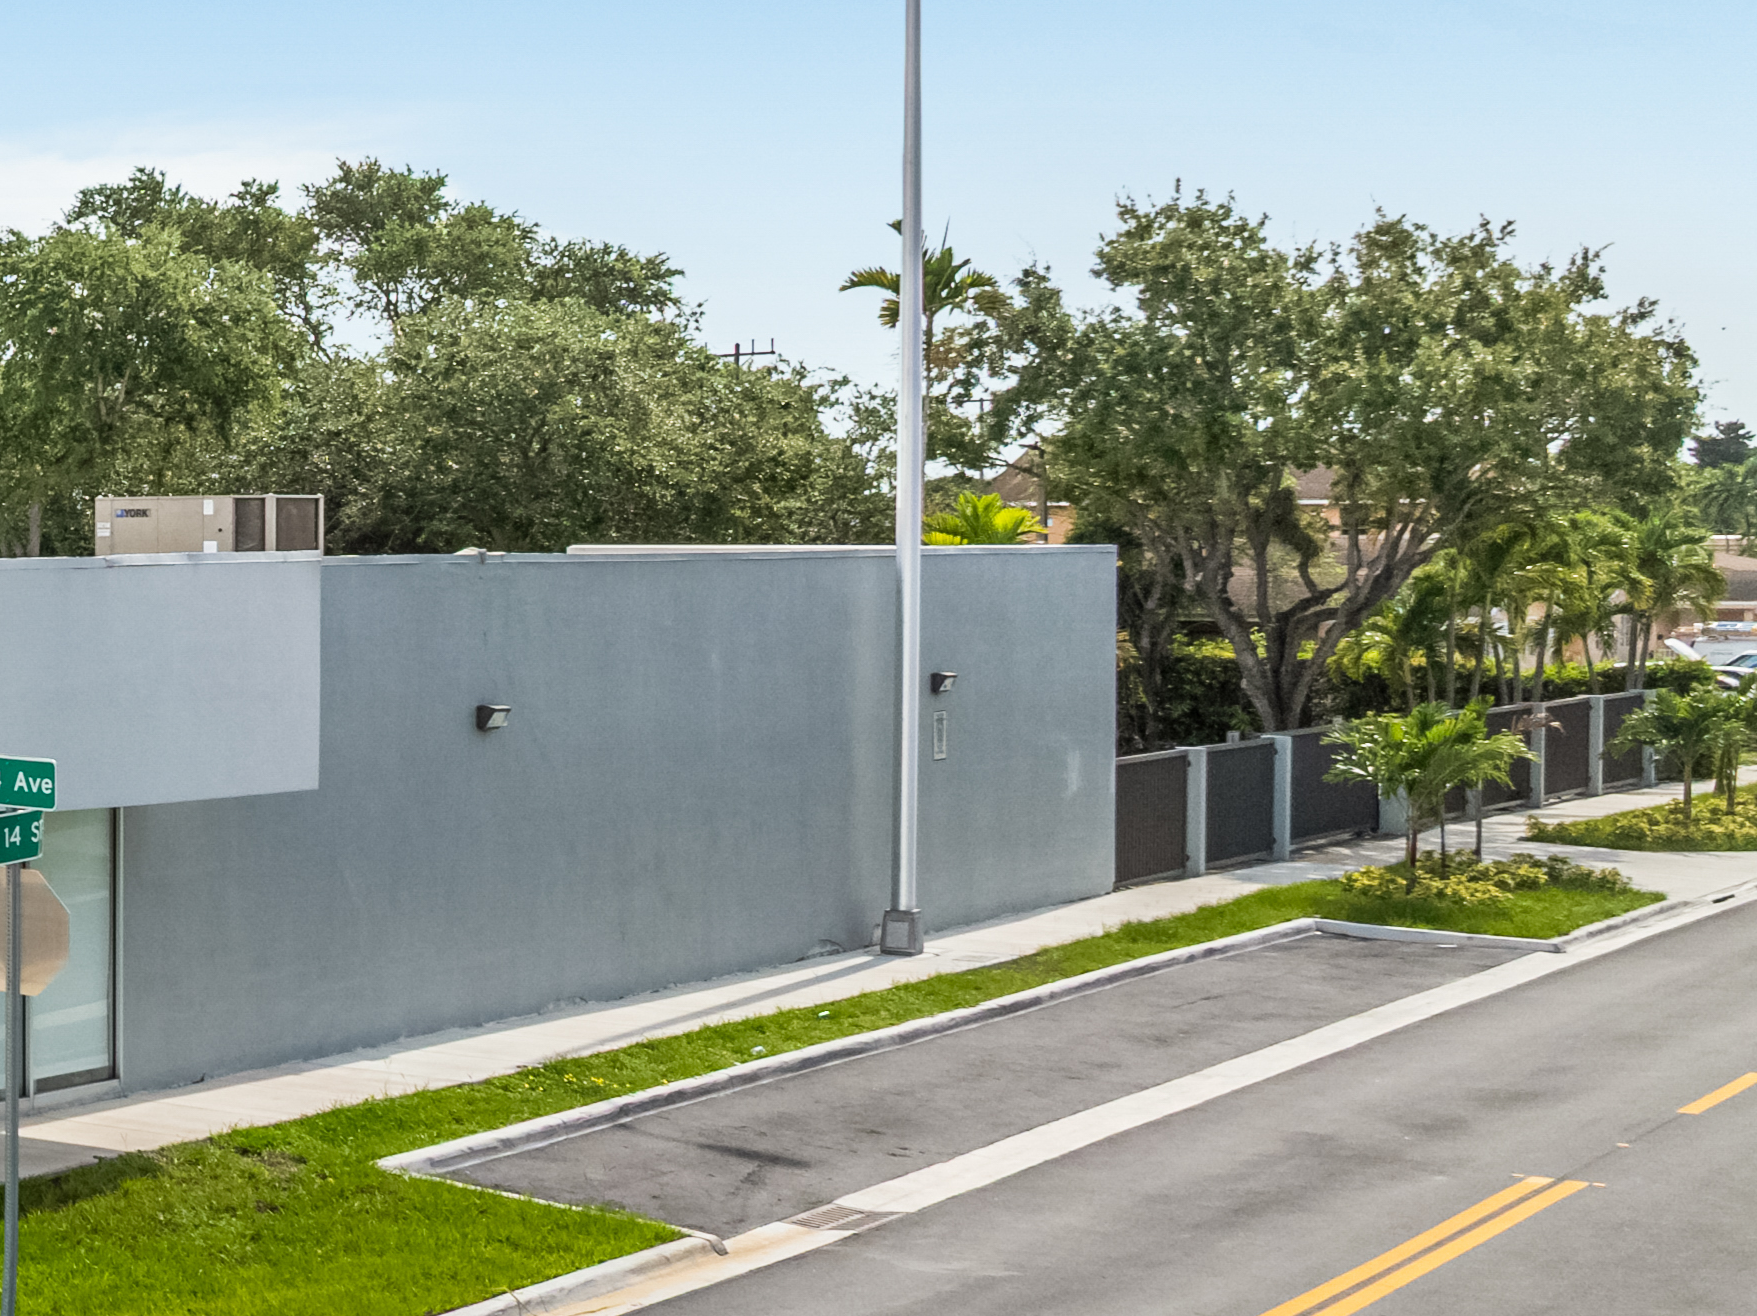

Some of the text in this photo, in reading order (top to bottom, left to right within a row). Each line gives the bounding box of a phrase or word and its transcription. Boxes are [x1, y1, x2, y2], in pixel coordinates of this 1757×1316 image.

[124, 509, 149, 518] YORK
[14, 771, 53, 795] Ave
[4, 825, 21, 848] 14
